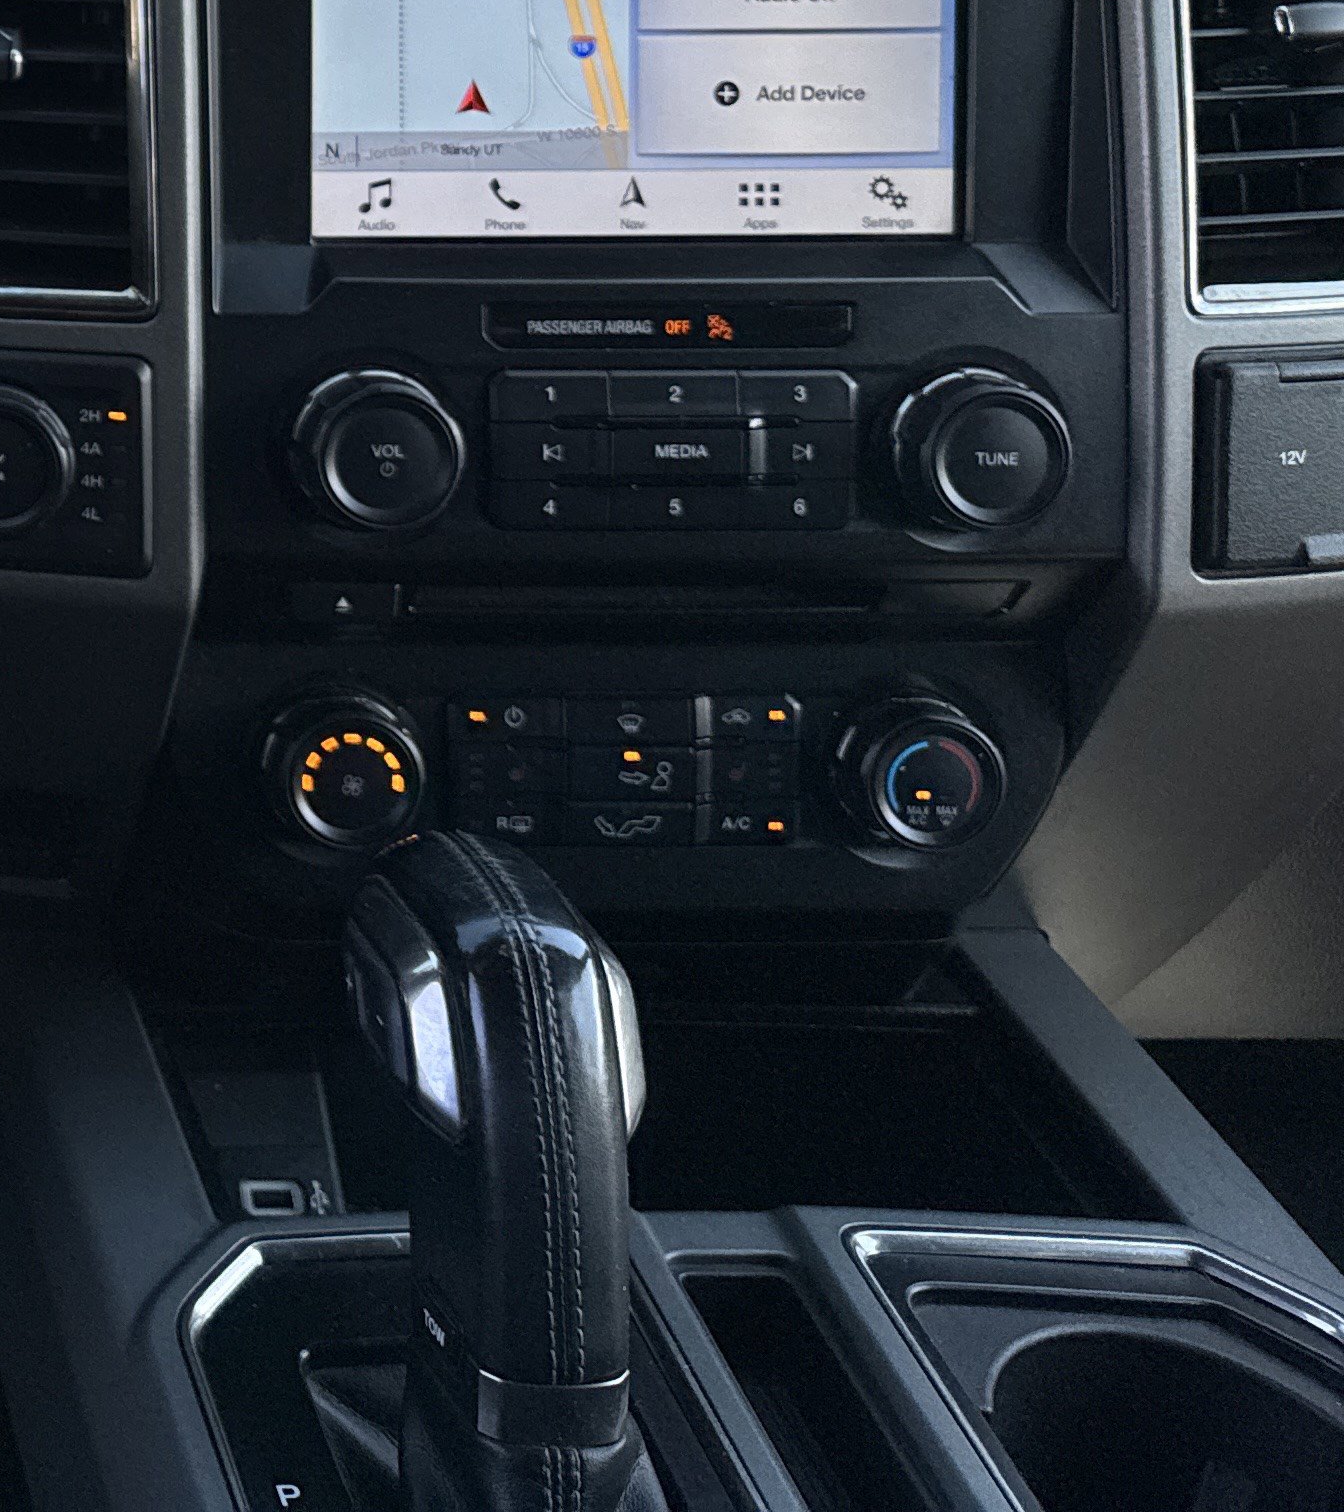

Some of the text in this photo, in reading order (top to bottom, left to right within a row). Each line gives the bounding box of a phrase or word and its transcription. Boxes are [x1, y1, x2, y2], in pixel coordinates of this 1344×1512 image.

[756, 84, 866, 102] Add Device
[325, 142, 340, 159] N
[483, 143, 504, 156] UT
[358, 218, 397, 232] Audio
[484, 218, 527, 231] Phone
[619, 218, 646, 230] Nav
[743, 217, 779, 230] Apps
[861, 215, 915, 230] Settings
[526, 319, 692, 336] PASSENGER AIRBAG OFF
[544, 386, 557, 403] 1
[668, 386, 683, 403] 2
[793, 385, 808, 403] 3
[78, 409, 101, 423] 2H
[80, 441, 103, 456] 4A
[370, 443, 406, 460] VOL
[654, 443, 710, 459] MEDIA
[974, 451, 1019, 467] TUNE
[1278, 448, 1308, 466] 12V
[80, 474, 104, 488] 4H
[81, 506, 103, 522] 4L
[543, 498, 557, 515] 4
[668, 498, 683, 516] 5
[792, 498, 807, 516] 6
[720, 816, 752, 831] A/C
[275, 1483, 301, 1507] P
